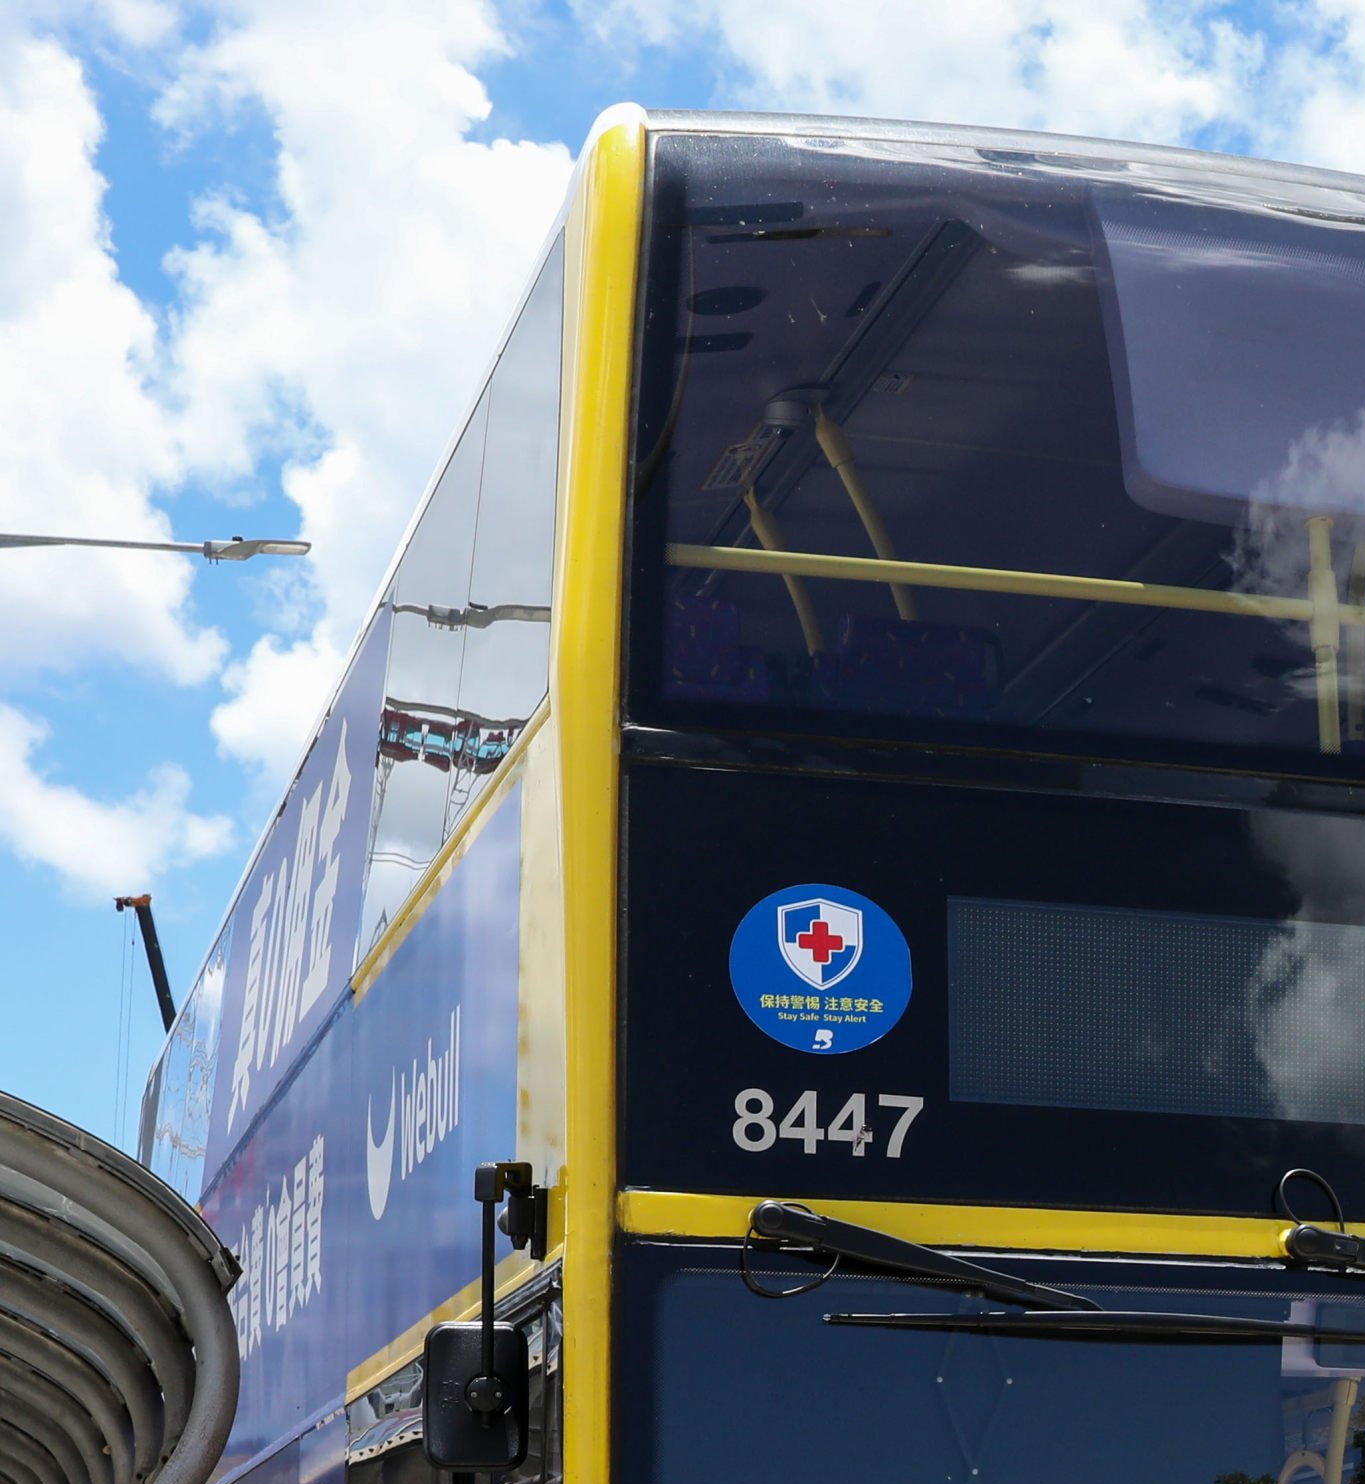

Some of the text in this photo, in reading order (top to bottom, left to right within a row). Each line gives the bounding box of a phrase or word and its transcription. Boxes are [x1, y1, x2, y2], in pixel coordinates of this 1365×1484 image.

[760, 994, 884, 1013] 保持警惕 注意安全
[778, 1012, 867, 1023] Stay Safe Stay Alert
[401, 1003, 460, 1180] Webull
[732, 1088, 924, 1158] 8447
